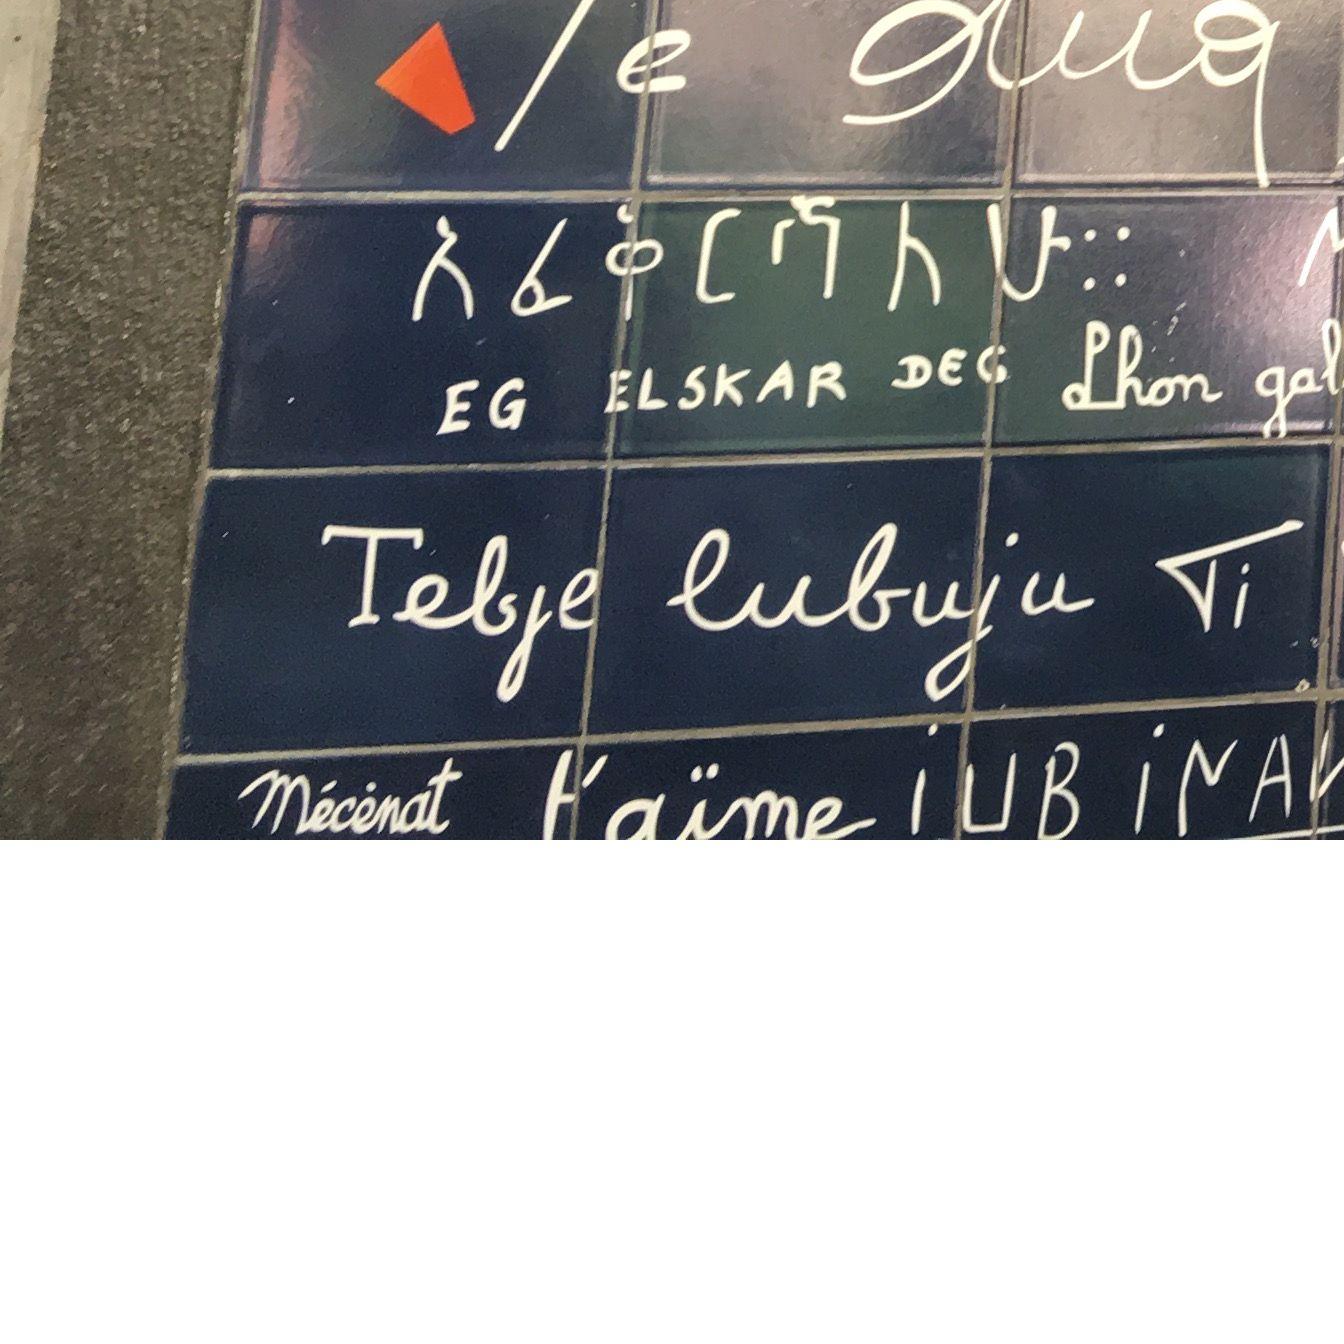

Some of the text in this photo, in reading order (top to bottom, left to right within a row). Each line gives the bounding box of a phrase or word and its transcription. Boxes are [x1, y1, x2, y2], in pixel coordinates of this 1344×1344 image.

[437, 375, 528, 434] EG
[604, 360, 847, 414] ELSKAR
[891, 344, 1009, 390] DEG
